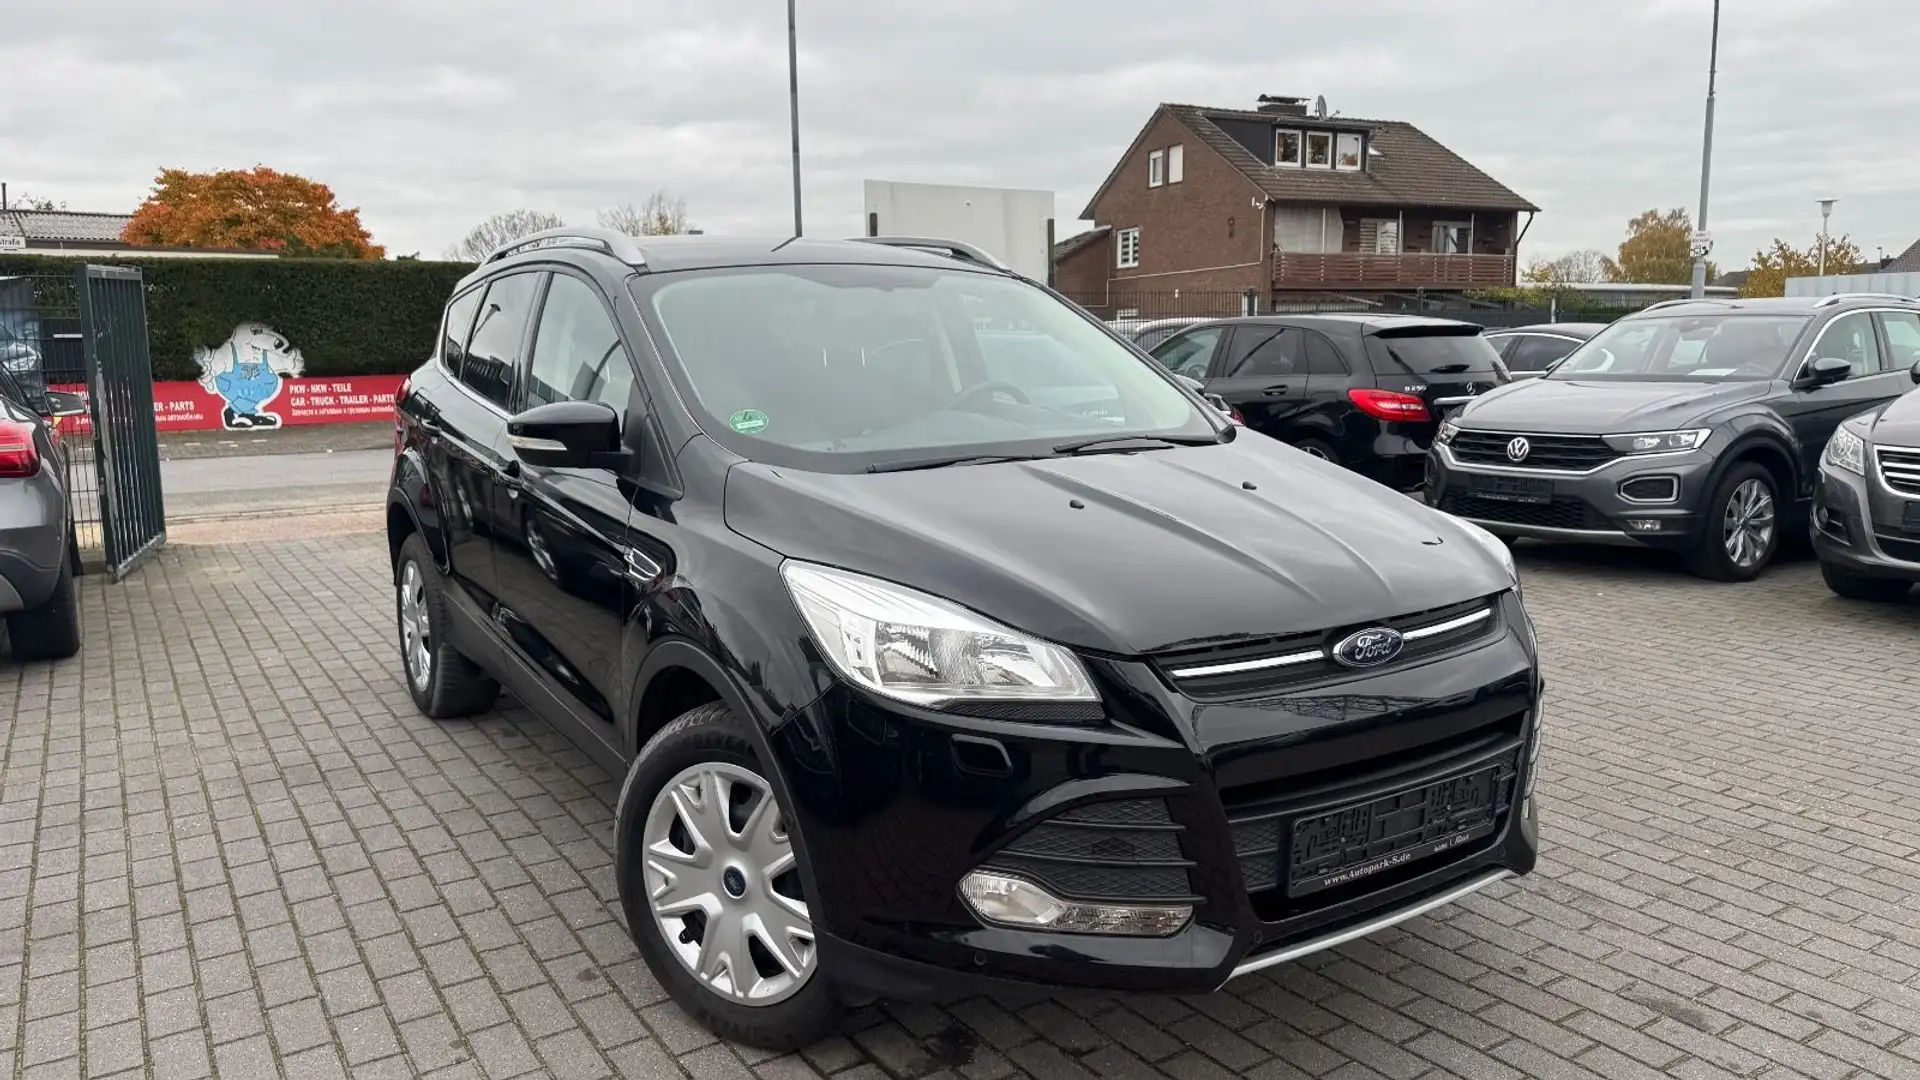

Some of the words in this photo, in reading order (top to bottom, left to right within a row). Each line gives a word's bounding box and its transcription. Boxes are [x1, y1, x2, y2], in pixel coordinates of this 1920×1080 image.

[289, 384, 306, 394] PKW
[332, 382, 352, 393] TEILE
[169, 401, 195, 412] PARTS
[291, 397, 306, 407] CAR
[310, 396, 334, 406] TRUCK
[339, 394, 369, 405] TRAILER
[373, 393, 395, 404] PARTS
[1354, 633, 1392, 660] Ford
